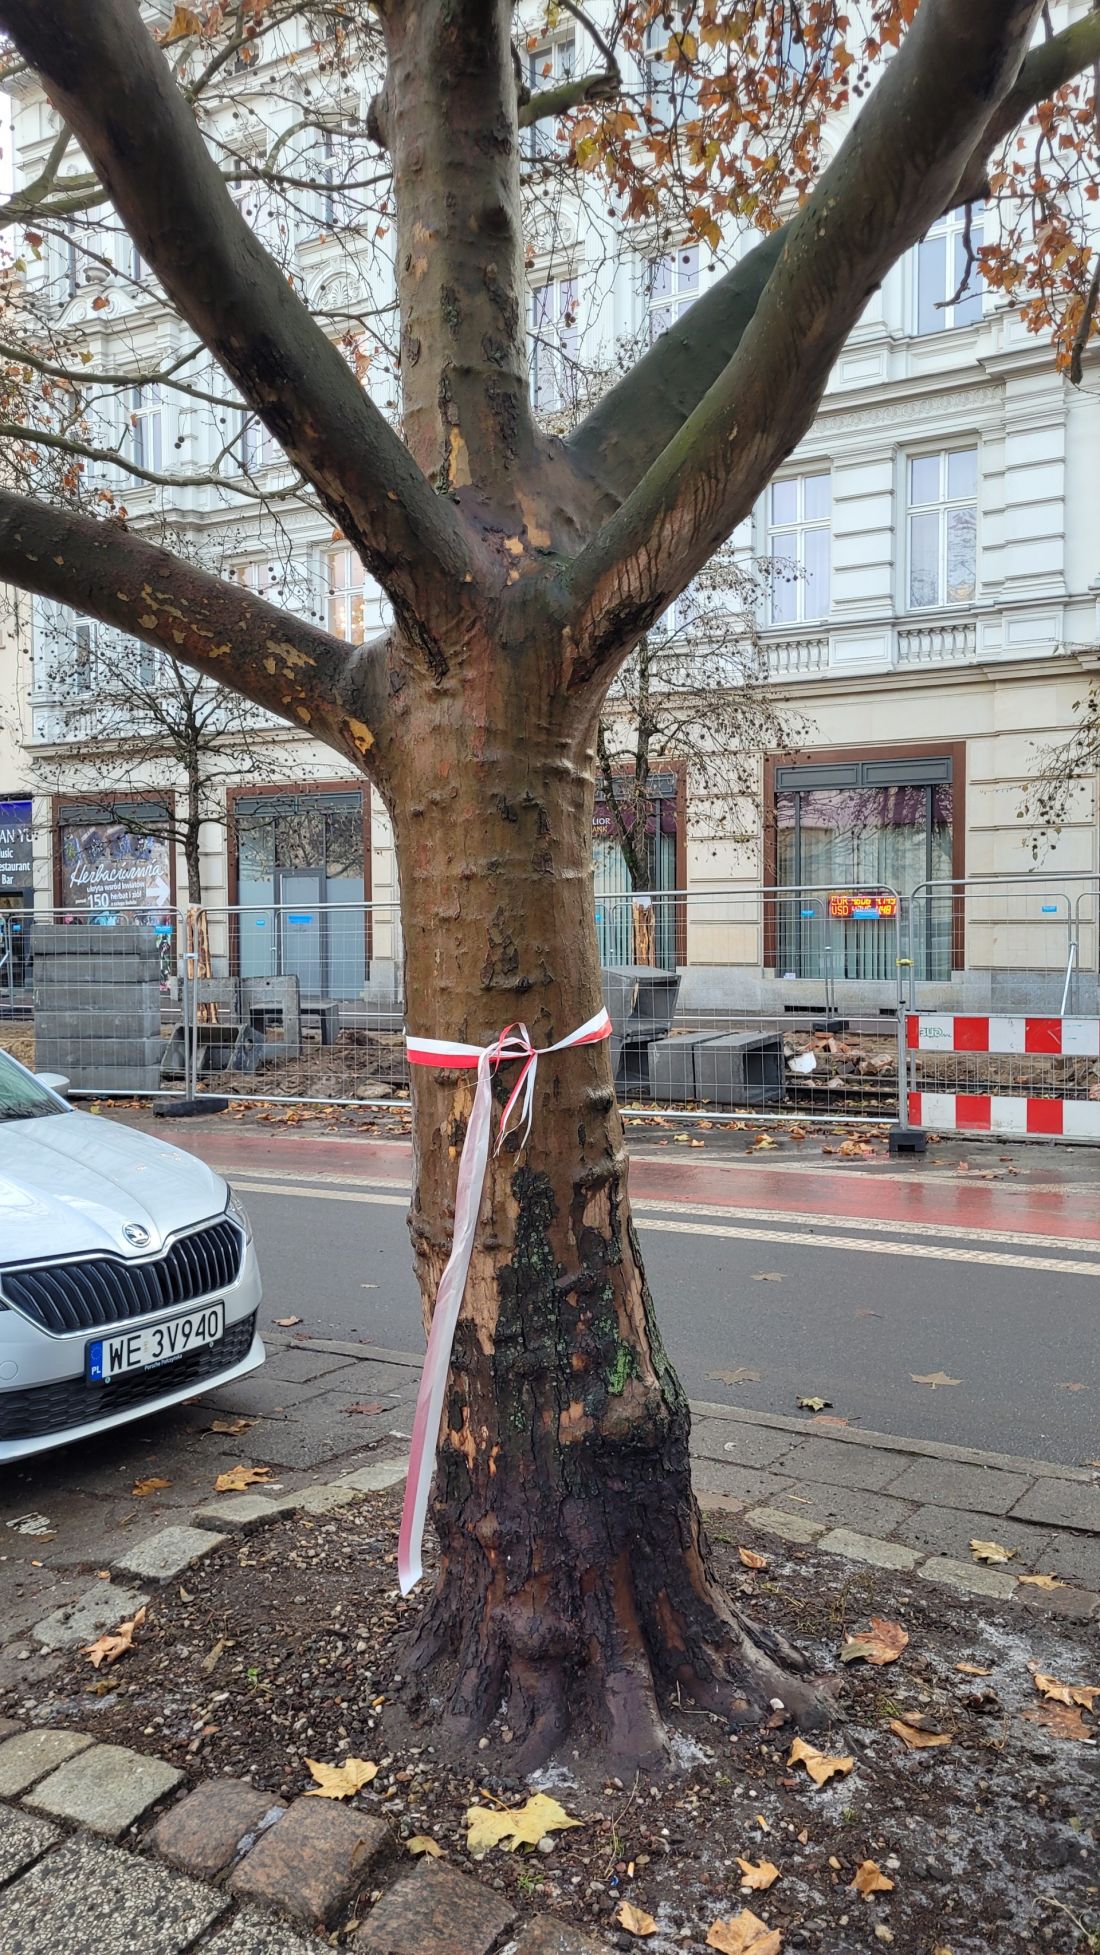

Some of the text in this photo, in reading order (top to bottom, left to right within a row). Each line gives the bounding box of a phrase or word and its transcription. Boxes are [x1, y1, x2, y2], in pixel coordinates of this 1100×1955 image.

[0, 847, 13, 858] usic
[1, 873, 14, 885] Bar
[87, 893, 109, 908] 150
[831, 906, 849, 915] USD
[109, 1310, 218, 1373] WE 3V940
[91, 1366, 101, 1376] PL
